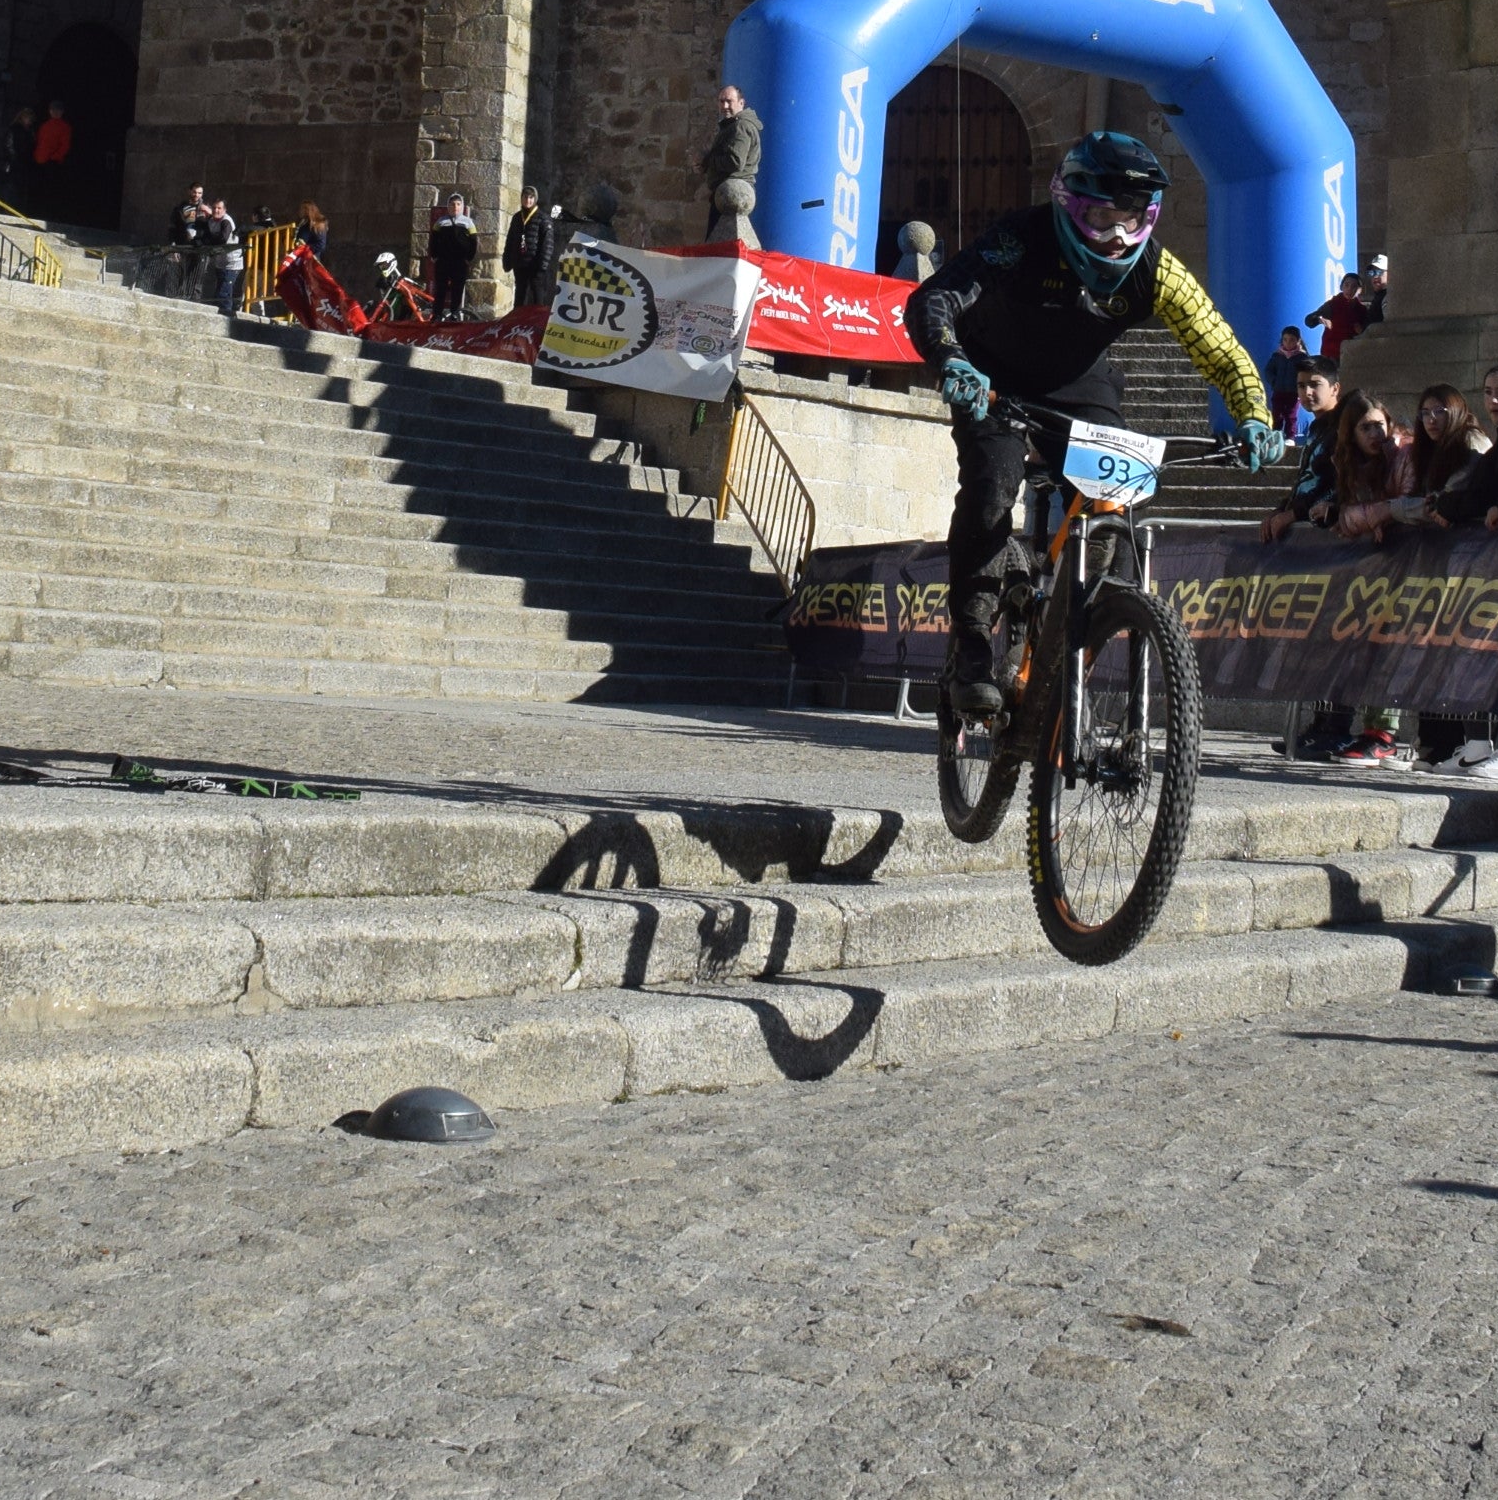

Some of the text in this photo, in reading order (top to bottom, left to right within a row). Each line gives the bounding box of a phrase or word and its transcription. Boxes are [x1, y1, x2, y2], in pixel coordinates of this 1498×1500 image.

[829, 66, 869, 269] RBEA
[1323, 161, 1346, 304] BEA
[1097, 455, 1131, 485] 93
